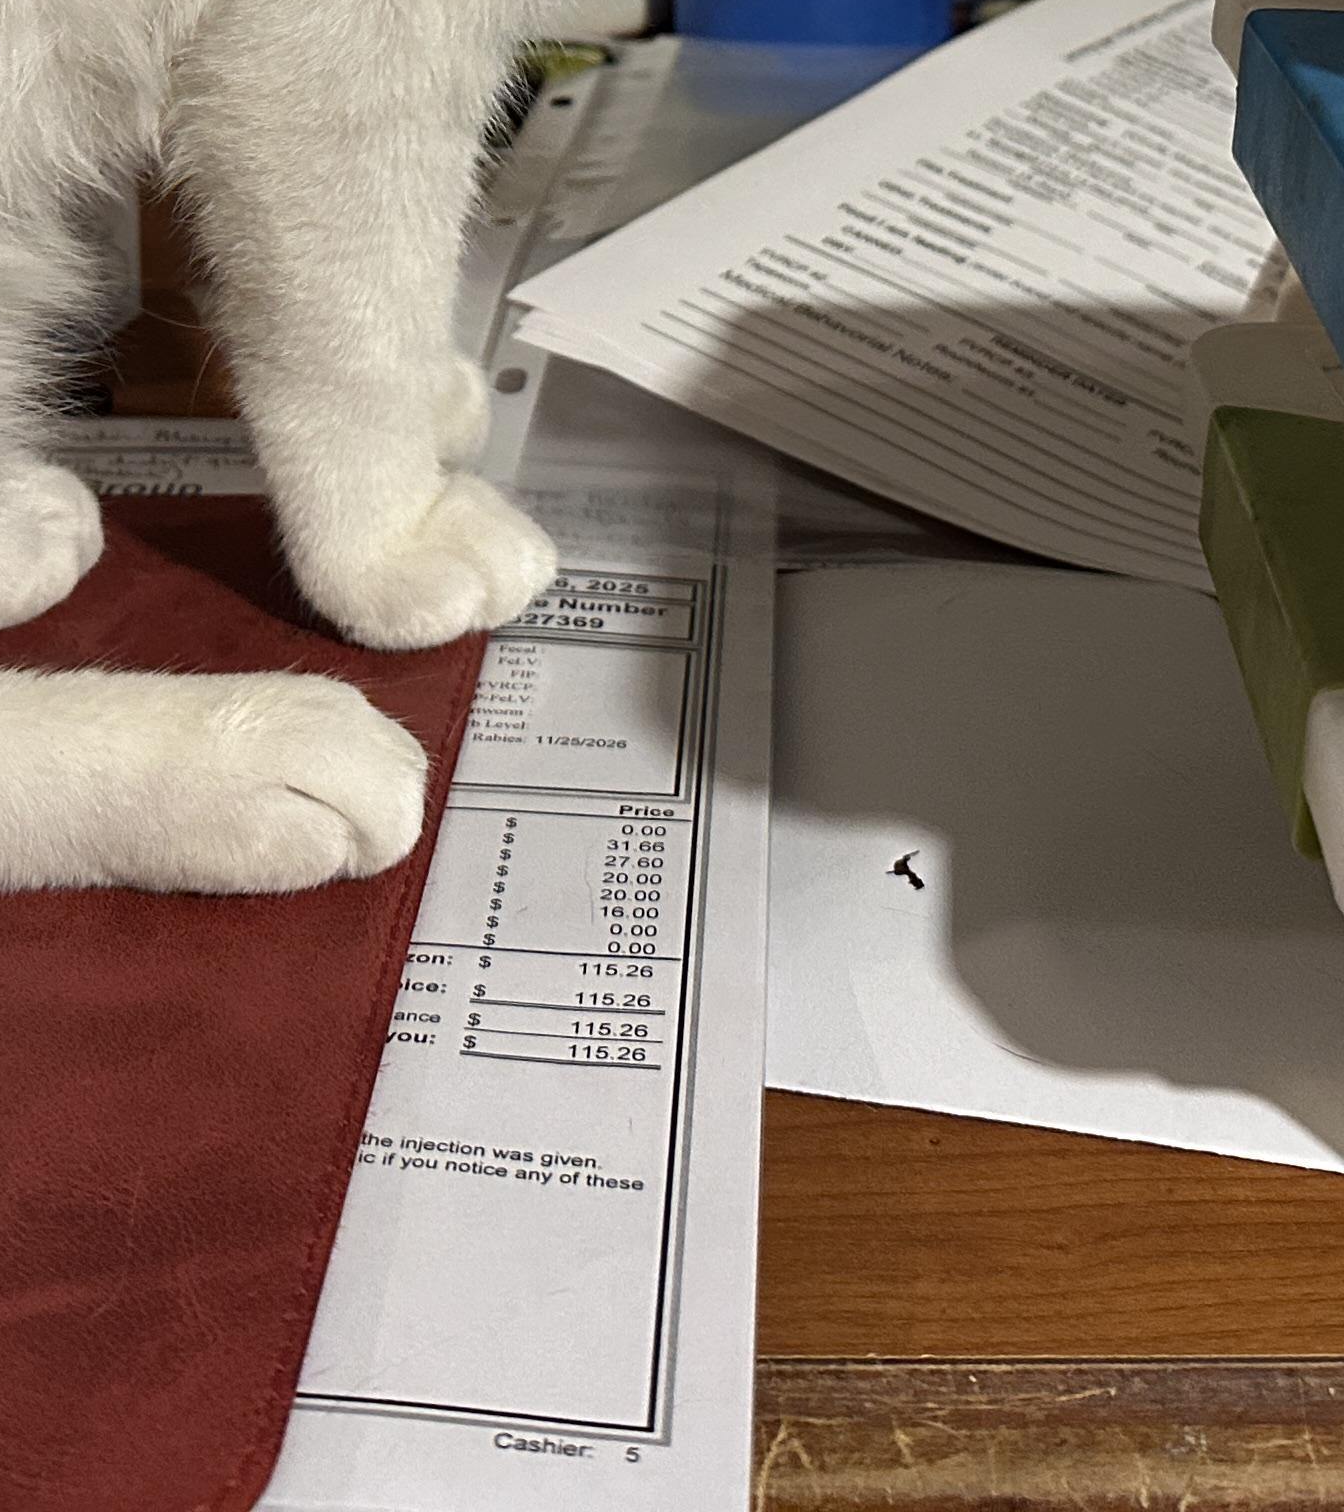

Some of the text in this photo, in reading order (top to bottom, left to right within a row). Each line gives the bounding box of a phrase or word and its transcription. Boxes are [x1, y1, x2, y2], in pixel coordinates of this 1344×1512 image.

[586, 579, 650, 594] 2025
[559, 597, 669, 616] Number
[536, 735, 628, 749] 11/25/2026
[618, 804, 675, 817] Price
[505, 816, 667, 837] $ 0.00
[502, 832, 666, 853] $ 31.66
[499, 848, 664, 869] $ 27.60
[496, 864, 663, 886] $ 20.00
[492, 881, 661, 902] $ 20.00
[489, 897, 660, 920] $ 16.00
[486, 915, 658, 937] $ 0.00
[482, 933, 656, 955] $ 0.00
[478, 954, 493, 969] $
[578, 962, 654, 978] 115.26
[472, 983, 487, 997] $
[574, 992, 652, 1007] 115.26
[393, 1010, 649, 1038] ance $ 115.26
[462, 1035, 477, 1049] $
[567, 1043, 647, 1061] 115.26
[360, 1131, 604, 1170] the injection was given.
[382, 1152, 397, 1166] if
[399, 1157, 439, 1170] you
[444, 1160, 509, 1178] notice
[515, 1168, 553, 1185] any
[559, 1171, 581, 1185] of
[586, 1173, 645, 1191] these
[625, 1446, 641, 1463] 5
